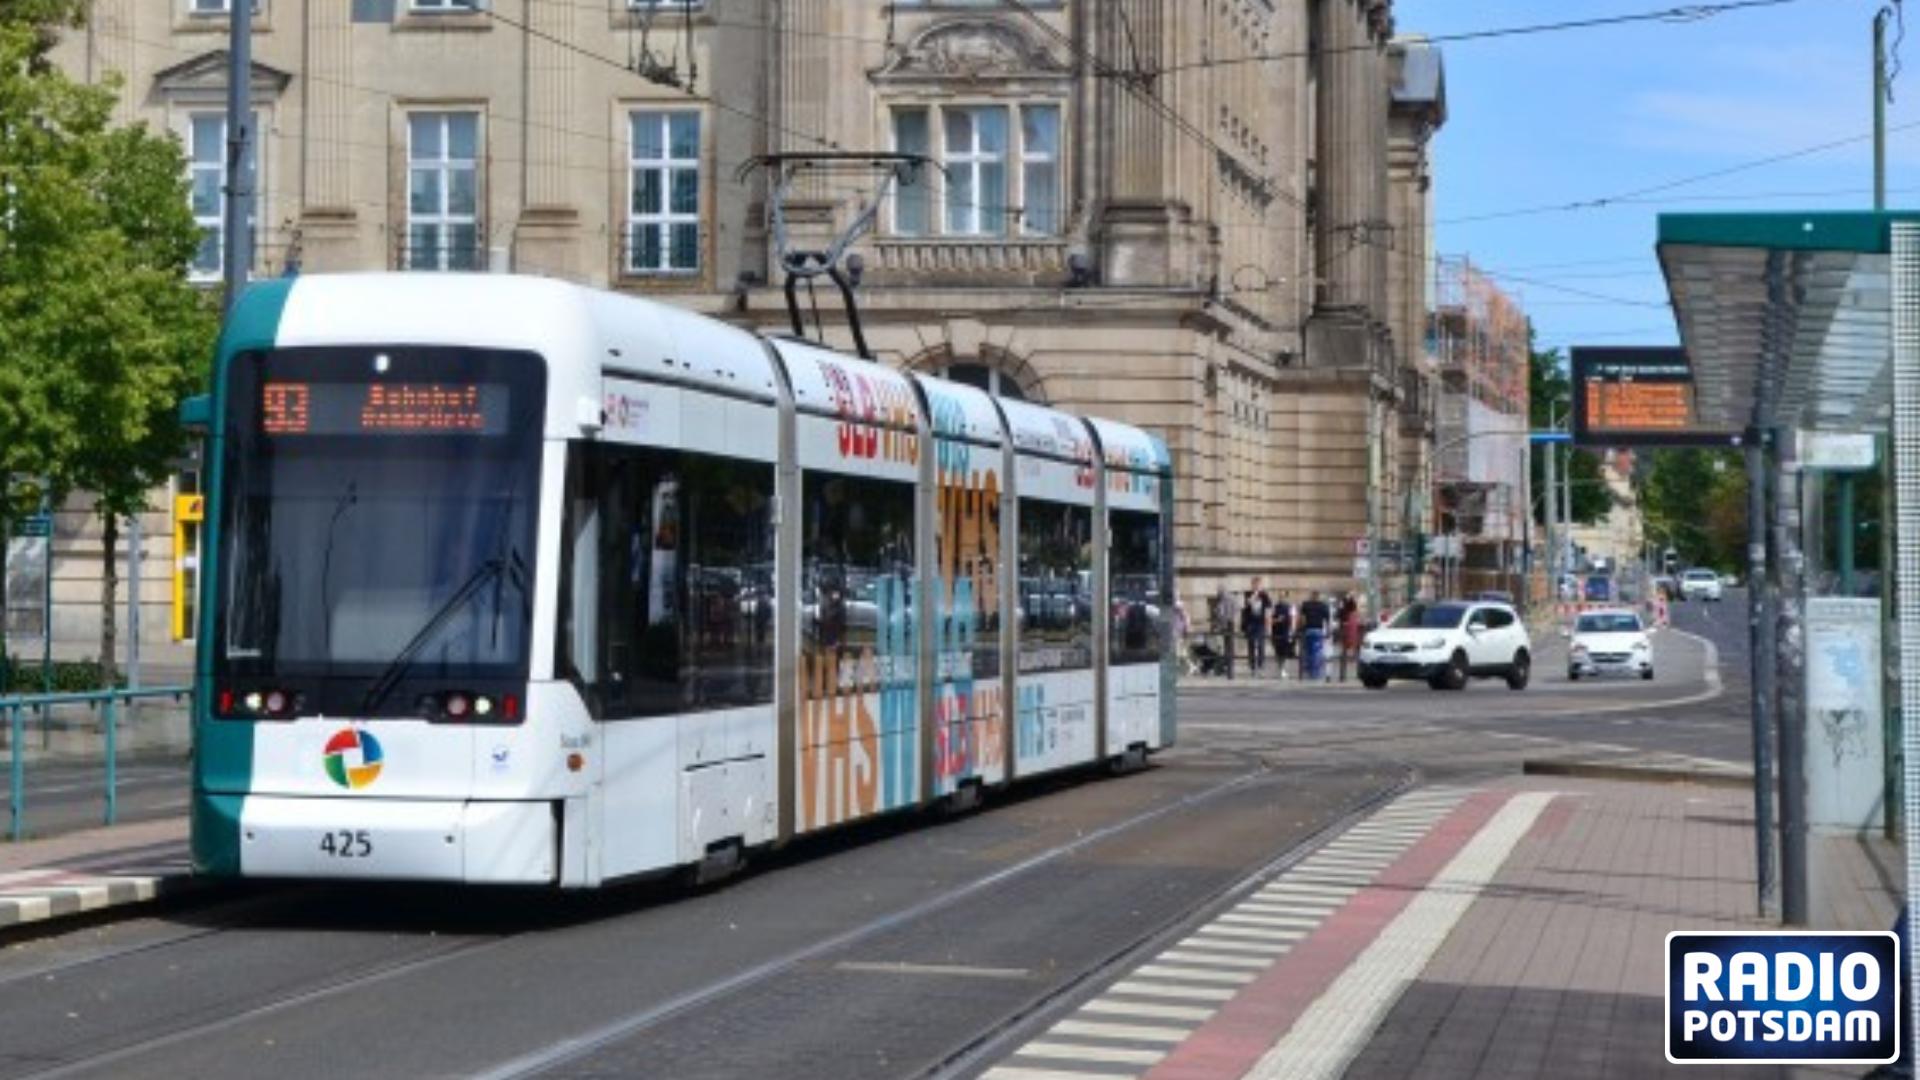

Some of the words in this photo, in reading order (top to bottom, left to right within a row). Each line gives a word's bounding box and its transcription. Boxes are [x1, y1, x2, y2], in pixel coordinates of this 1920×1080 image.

[264, 384, 308, 432] 93
[369, 384, 476, 406] Bahnhof
[799, 647, 880, 832] VHS
[319, 831, 373, 858] 425
